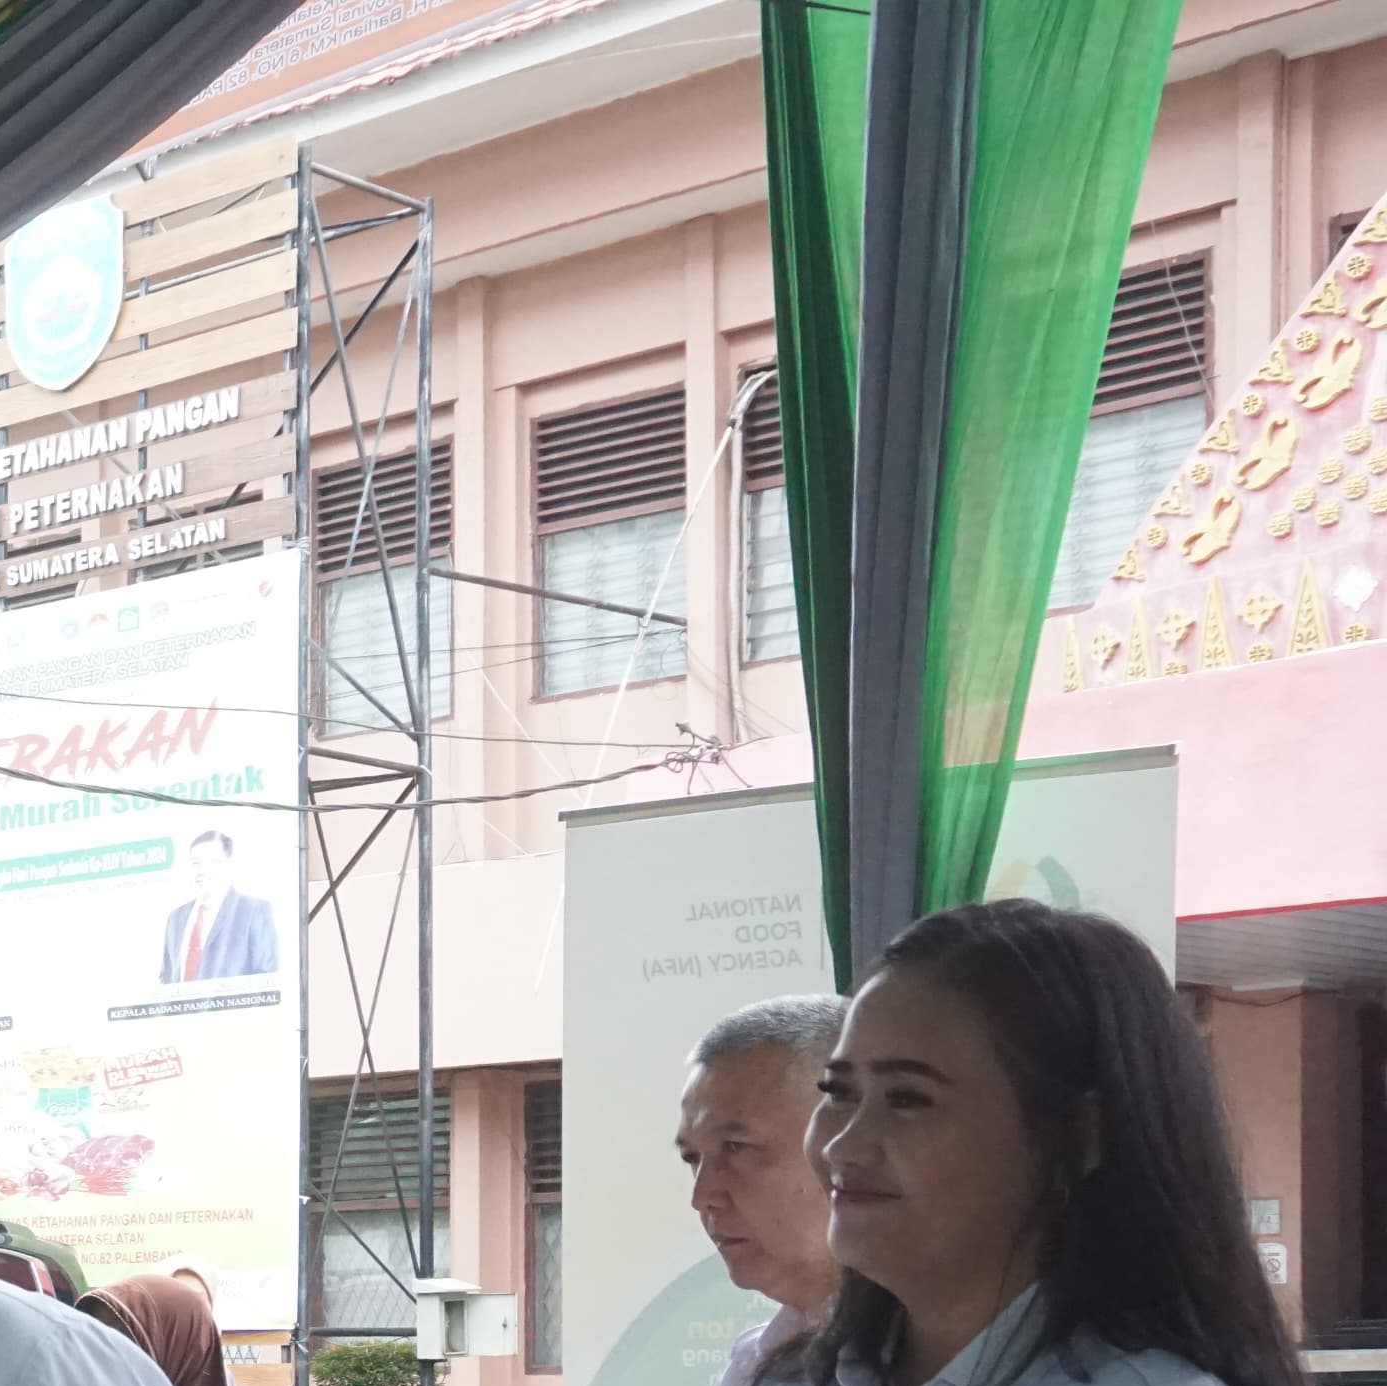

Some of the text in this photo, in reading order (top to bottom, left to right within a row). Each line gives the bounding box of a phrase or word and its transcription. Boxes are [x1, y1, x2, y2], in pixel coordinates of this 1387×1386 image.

[135, 387, 240, 442] PANGAN
[9, 463, 183, 534] PETERNAKAN
[7, 544, 120, 587] SUMATERA
[128, 518, 226, 560] SELATAN
[38, 651, 103, 680] PANGAN
[105, 643, 139, 665] DAN
[142, 620, 257, 657] PETERNAKAN
[28, 667, 116, 697] SUMATERA
[116, 651, 190, 679] SELATAN
[0, 791, 101, 832] Murah
[110, 764, 267, 813] Serentak
[111, 994, 278, 1019] KEPALA BADAN PANGAN NASIONAL
[105, 1046, 177, 1073] MURAH
[32, 1216, 97, 1229] KETAHANAN
[101, 1213, 146, 1226] PANGAN
[149, 1211, 173, 1225] DAN
[176, 1208, 254, 1224] PETERNAKAN
[96, 1233, 145, 1245] SELATAN
[81, 1252, 111, 1265] NO.82
